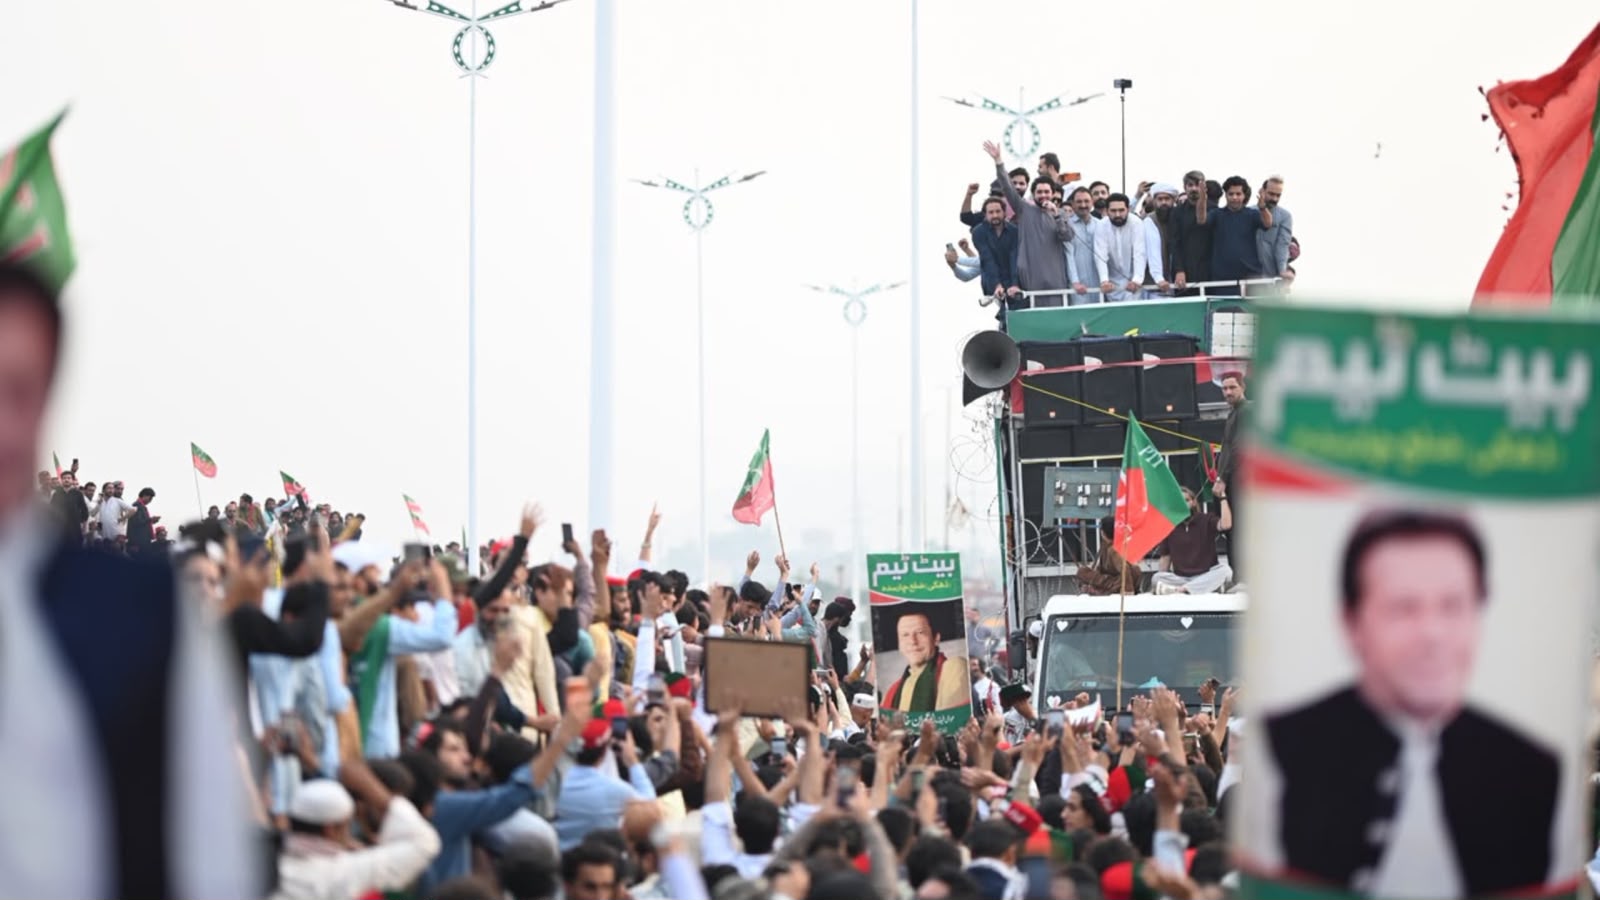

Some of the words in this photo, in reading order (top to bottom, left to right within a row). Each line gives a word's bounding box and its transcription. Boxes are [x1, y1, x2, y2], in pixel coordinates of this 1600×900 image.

[1138, 445, 1164, 469] PTI
[872, 554, 909, 587] ٹیم
[912, 556, 955, 578] بیٹ
